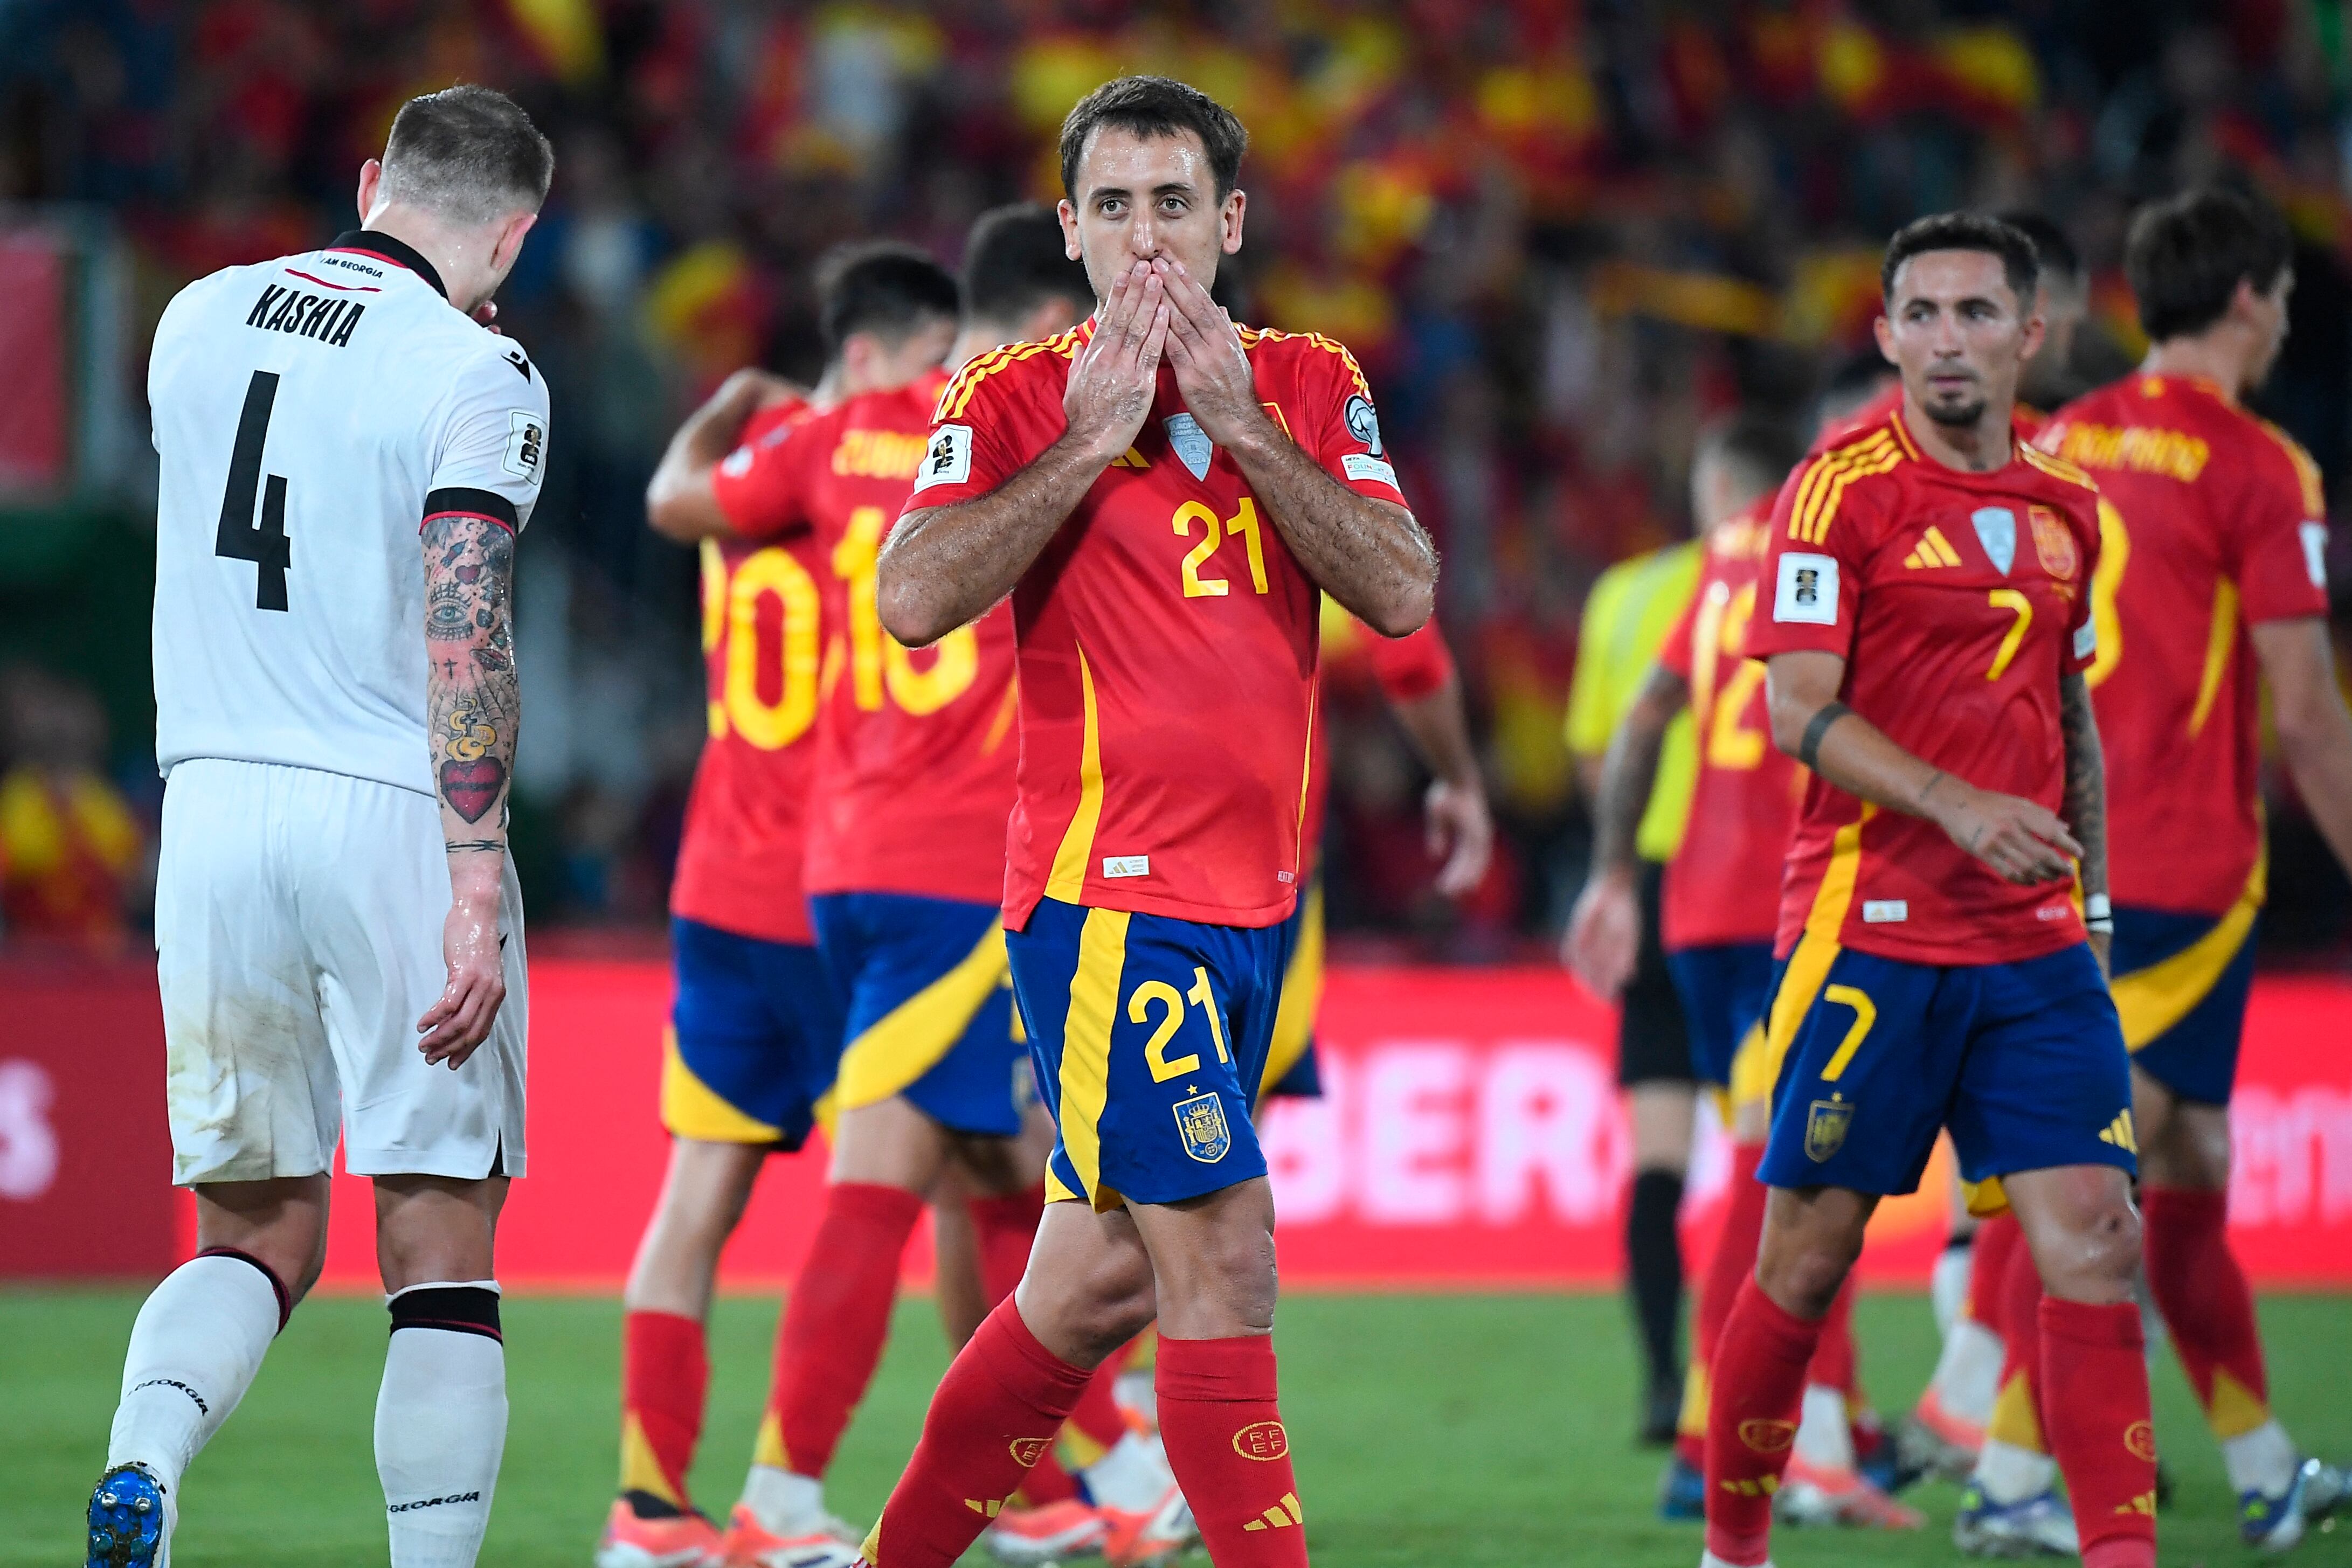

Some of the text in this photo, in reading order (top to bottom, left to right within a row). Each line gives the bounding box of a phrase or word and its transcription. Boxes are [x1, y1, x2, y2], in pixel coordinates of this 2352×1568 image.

[324, 258, 340, 266] AM
[340, 260, 383, 279] GEORGIA
[245, 283, 366, 348] KASHIA
[215, 370, 292, 613] 4
[1172, 496, 1269, 599] 21
[1987, 588, 2033, 681] 7
[1127, 966, 1229, 1084] 21
[1821, 983, 1877, 1081] 7
[134, 1379, 209, 1417] GEORGIA
[390, 1491, 480, 1513] GEORGIA
